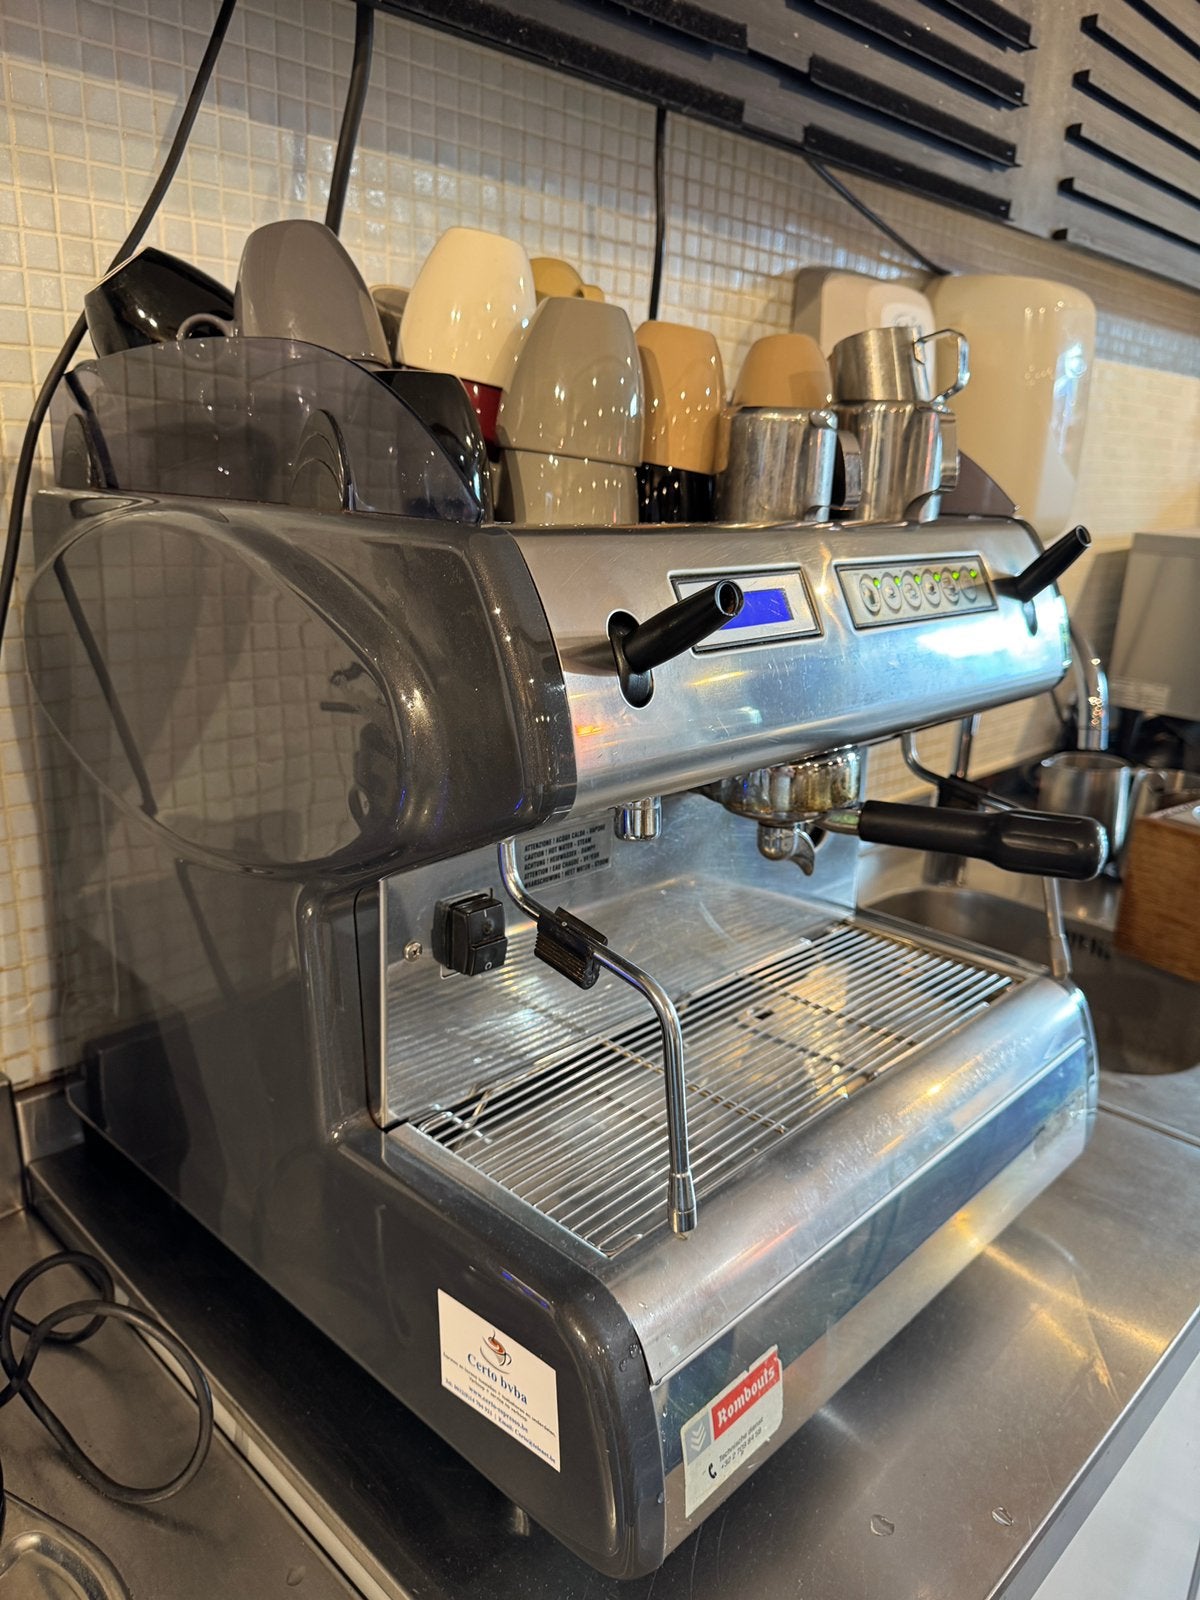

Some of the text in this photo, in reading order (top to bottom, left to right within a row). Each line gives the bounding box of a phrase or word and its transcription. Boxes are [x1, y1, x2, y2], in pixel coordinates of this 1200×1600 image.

[525, 839, 552, 852] ATTENZIONE
[556, 834, 571, 843] ACQUA
[572, 830, 586, 839] CALDA
[525, 850, 544, 861] CAUTION
[549, 846, 558, 854] HOT
[559, 841, 573, 851] WATER
[578, 837, 592, 846] STEAM
[525, 859, 545, 870] ACHTUNG
[581, 844, 596, 854] DAMPF
[525, 868, 548, 880] ATTENTION
[553, 863, 561, 872] EAU
[562, 858, 579, 868] CHAUDE
[577, 864, 591, 872] WATER
[467, 1353, 497, 1382] Certo
[500, 1375, 527, 1405] bvba
[717, 1366, 775, 1428] Rombouts
[719, 1433, 747, 1462] Technische
